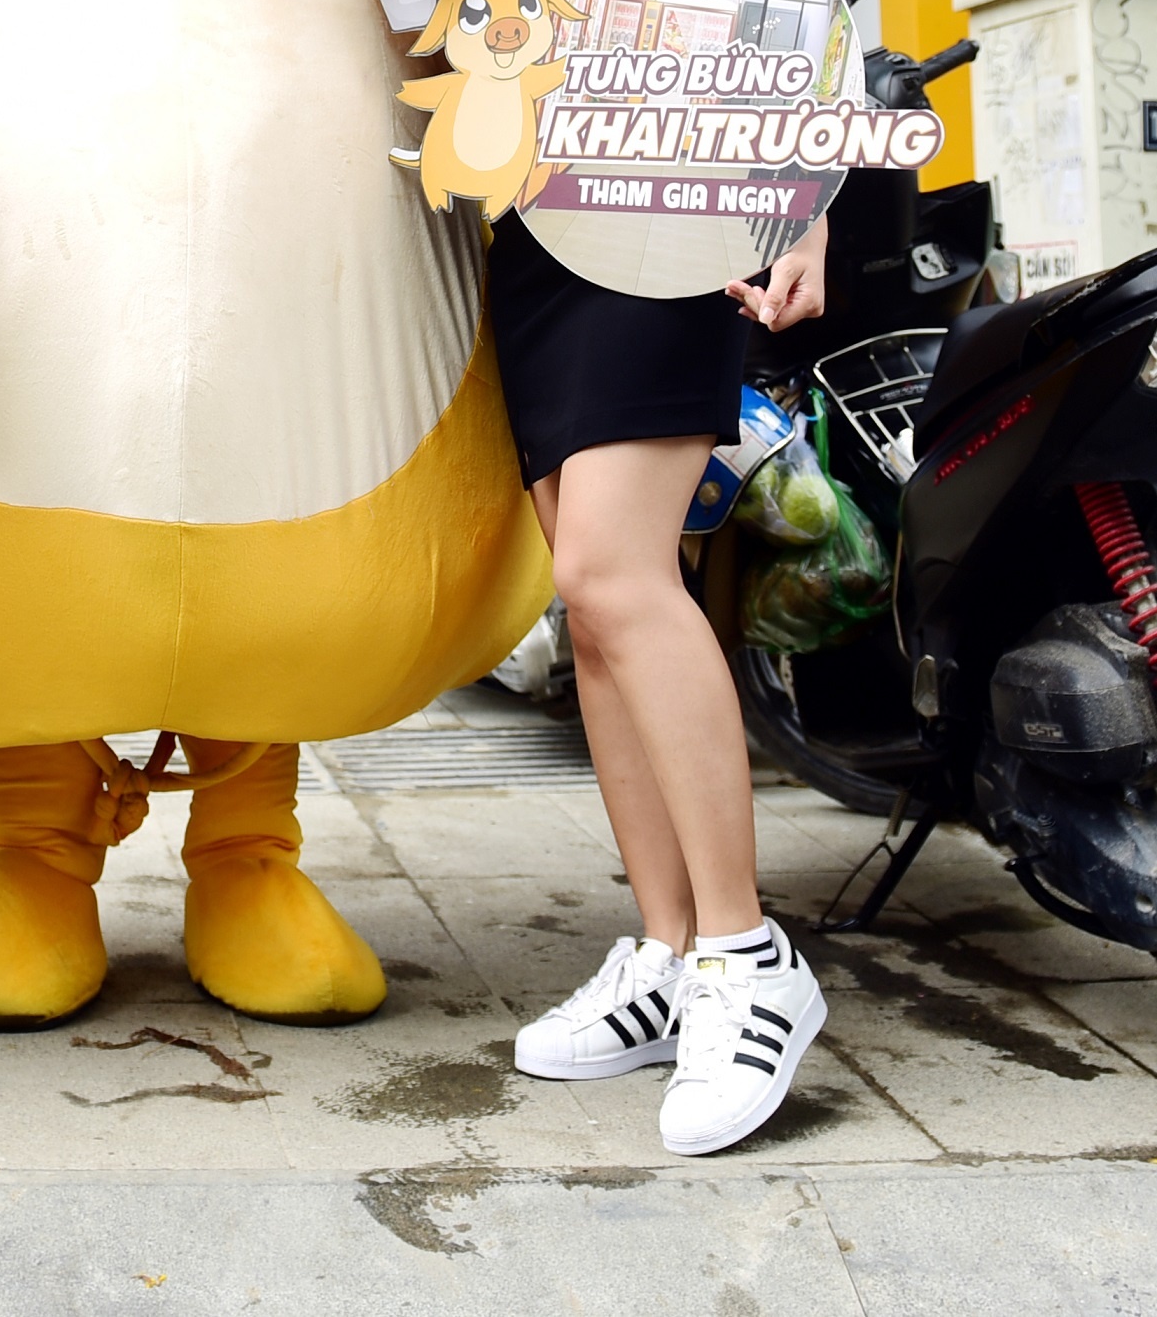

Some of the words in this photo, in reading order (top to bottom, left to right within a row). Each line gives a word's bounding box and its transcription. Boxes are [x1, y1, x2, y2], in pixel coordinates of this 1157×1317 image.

[565, 47, 681, 95] TƯNG
[684, 45, 812, 96] BỪNG
[544, 107, 688, 161] KHAI
[690, 100, 942, 168] TRƯƠNG
[578, 178, 653, 208] THAM
[662, 183, 708, 211] GIA
[717, 185, 796, 215] NGAY
